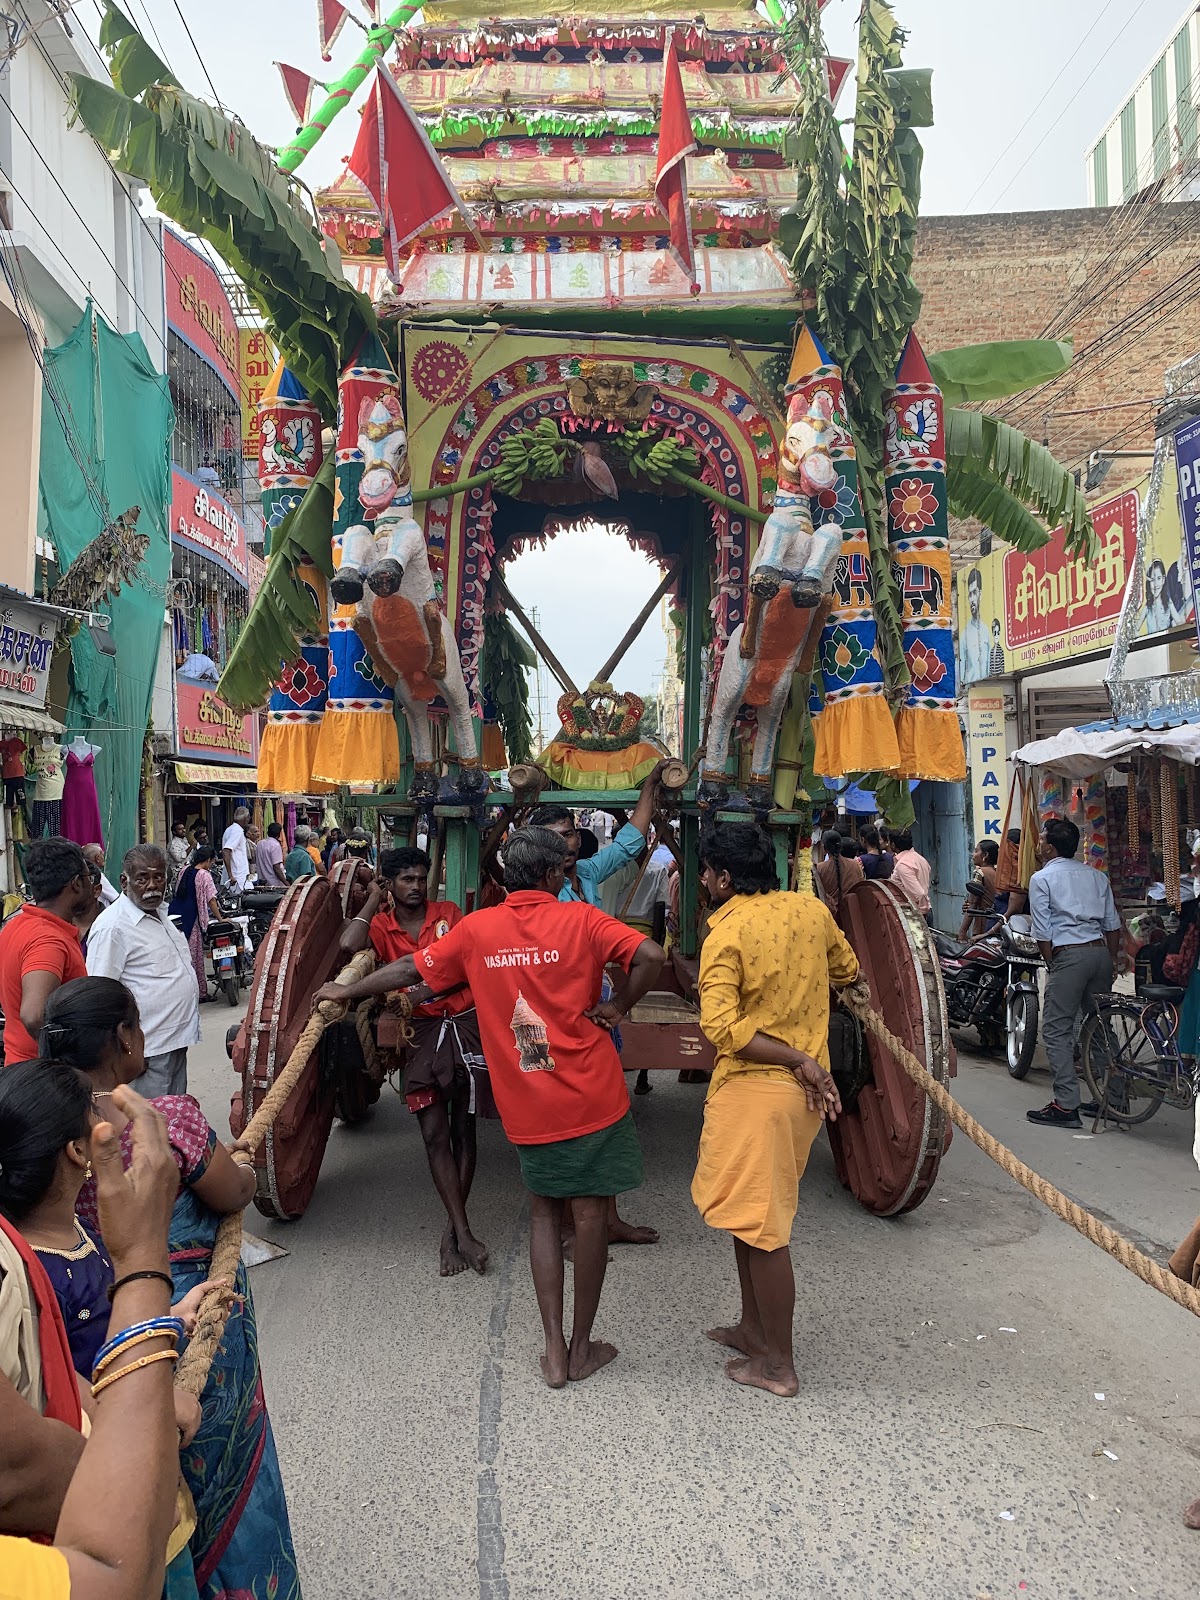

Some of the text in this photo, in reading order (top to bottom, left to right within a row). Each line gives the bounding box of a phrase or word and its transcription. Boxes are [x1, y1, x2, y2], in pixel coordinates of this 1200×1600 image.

[194, 488, 239, 549] சிவந்தி
[1042, 637, 1066, 655] ஜவுளி
[424, 955, 435, 967] CO
[484, 950, 560, 968] VASANTH & CO
